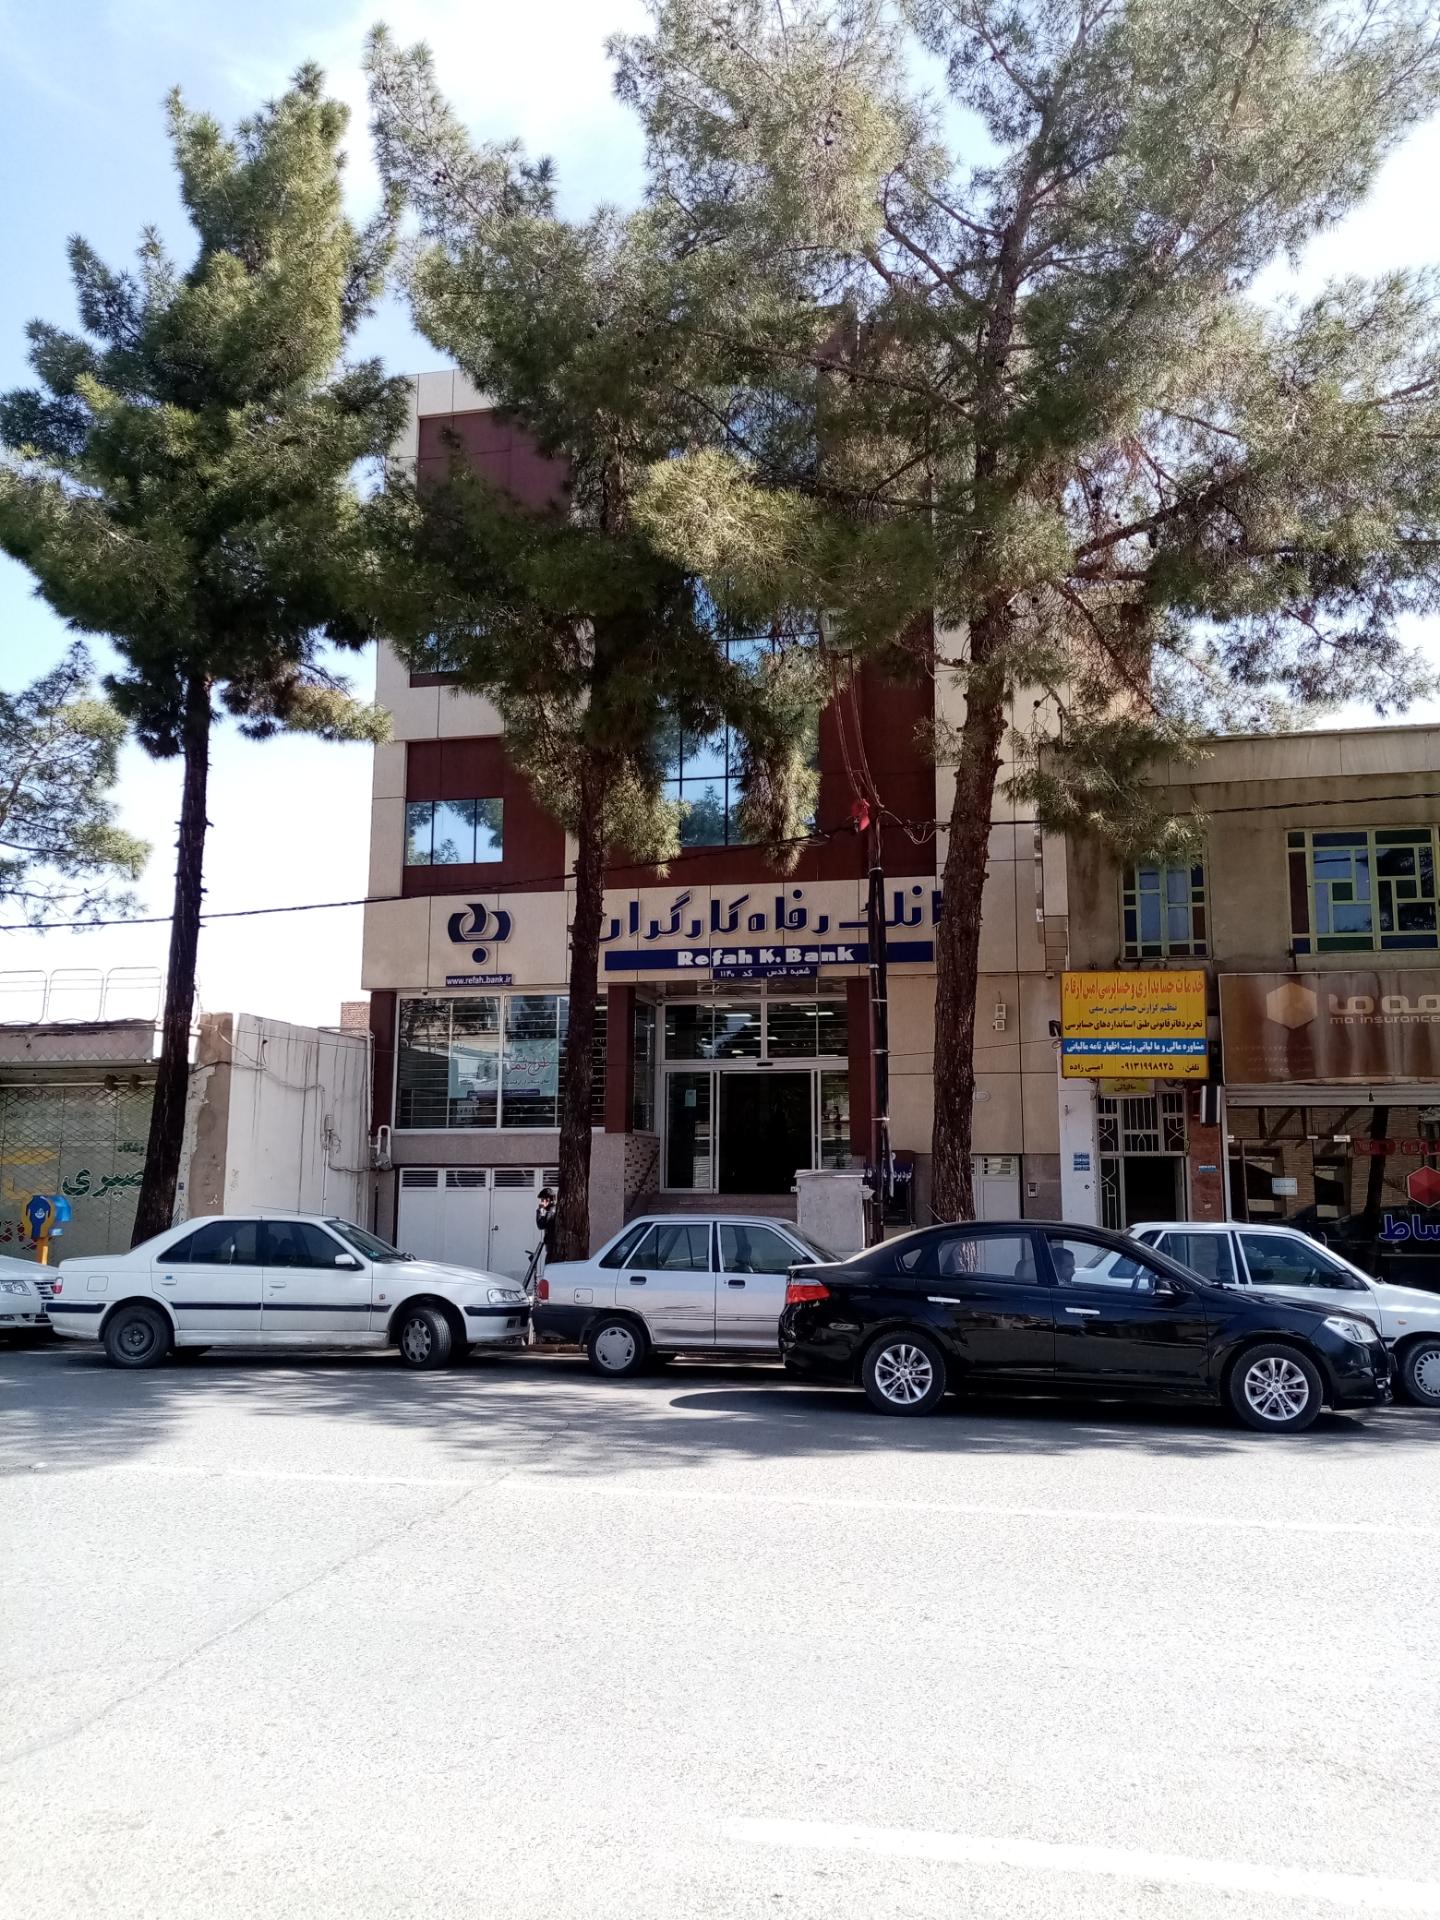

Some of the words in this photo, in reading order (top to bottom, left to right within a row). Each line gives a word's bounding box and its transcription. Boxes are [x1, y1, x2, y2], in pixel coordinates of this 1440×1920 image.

[837, 883, 941, 928] انک
[746, 889, 831, 936] رفاه
[676, 949, 753, 967] Refah
[759, 948, 781, 965] K.
[785, 946, 855, 963] Bank
[742, 969, 753, 977] کد
[766, 967, 787, 977] قدس
[790, 967, 811, 977] شعبه
[446, 975, 512, 985] www.refah.bank.ir
[1176, 975, 1204, 993] خدمات
[1135, 976, 1175, 998] حسابداری
[1136, 1019, 1150, 1030] طبق
[1089, 1041, 1102, 1051] نامه
[1102, 1041, 1120, 1053] اظهار
[1161, 1045, 1166, 1053] و
[1166, 1041, 1182, 1053] مالی
[1182, 1041, 1205, 1053] مشاوره
[1069, 1063, 1085, 1073] زاده
